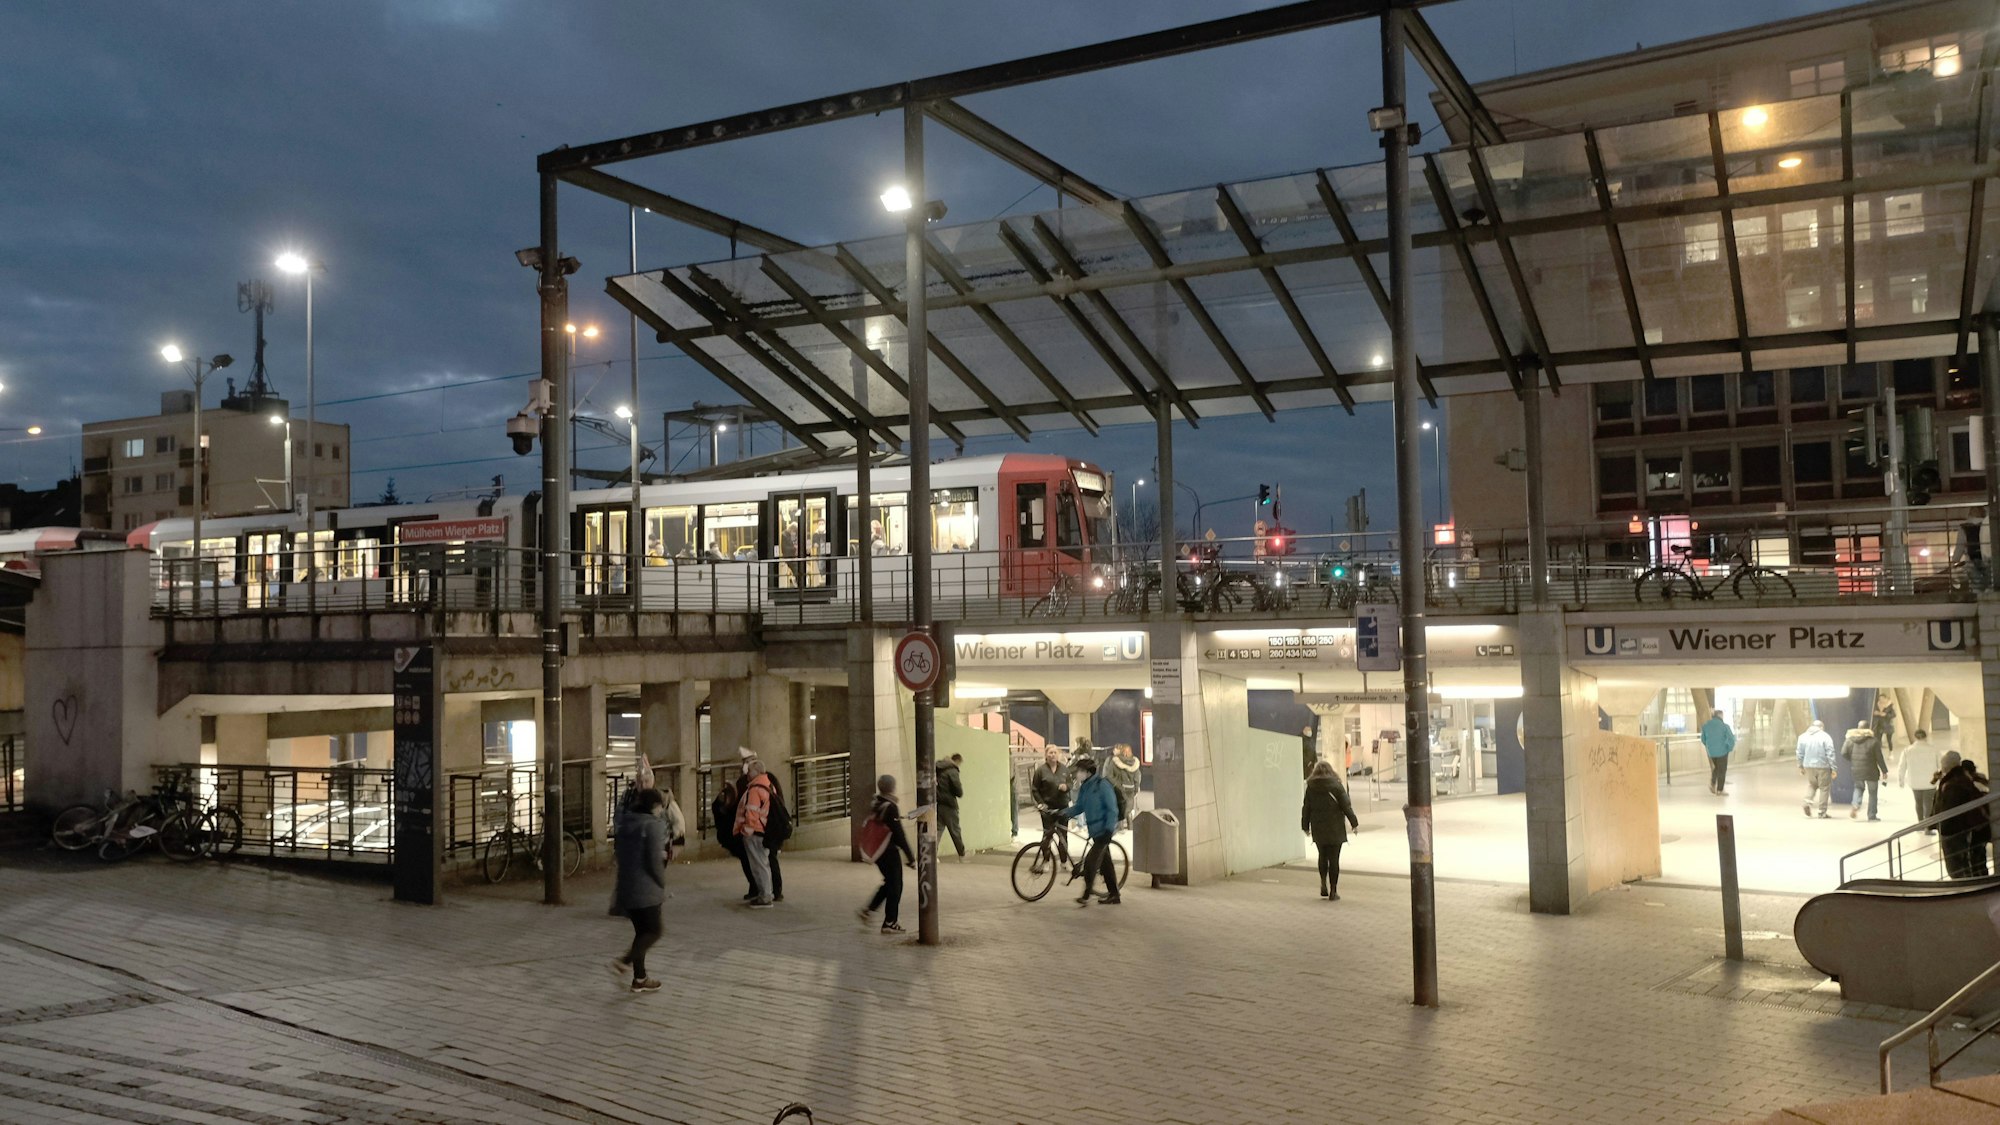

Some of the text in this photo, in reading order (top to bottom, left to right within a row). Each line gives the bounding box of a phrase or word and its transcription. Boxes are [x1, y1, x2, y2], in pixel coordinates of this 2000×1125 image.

[405, 524, 500, 539] Mülheim Wiener Platz
[1586, 628, 1613, 654] U
[1668, 626, 1865, 650] Wiener Platz
[1930, 621, 1962, 649] U
[956, 641, 1085, 660] Wiener Platz
[1122, 635, 1143, 660] U
[1229, 650, 1236, 658] 4
[1240, 650, 1249, 658] 13
[1251, 650, 1260, 658] 18
[1269, 650, 1284, 658] 260
[1286, 649, 1300, 658] 434
